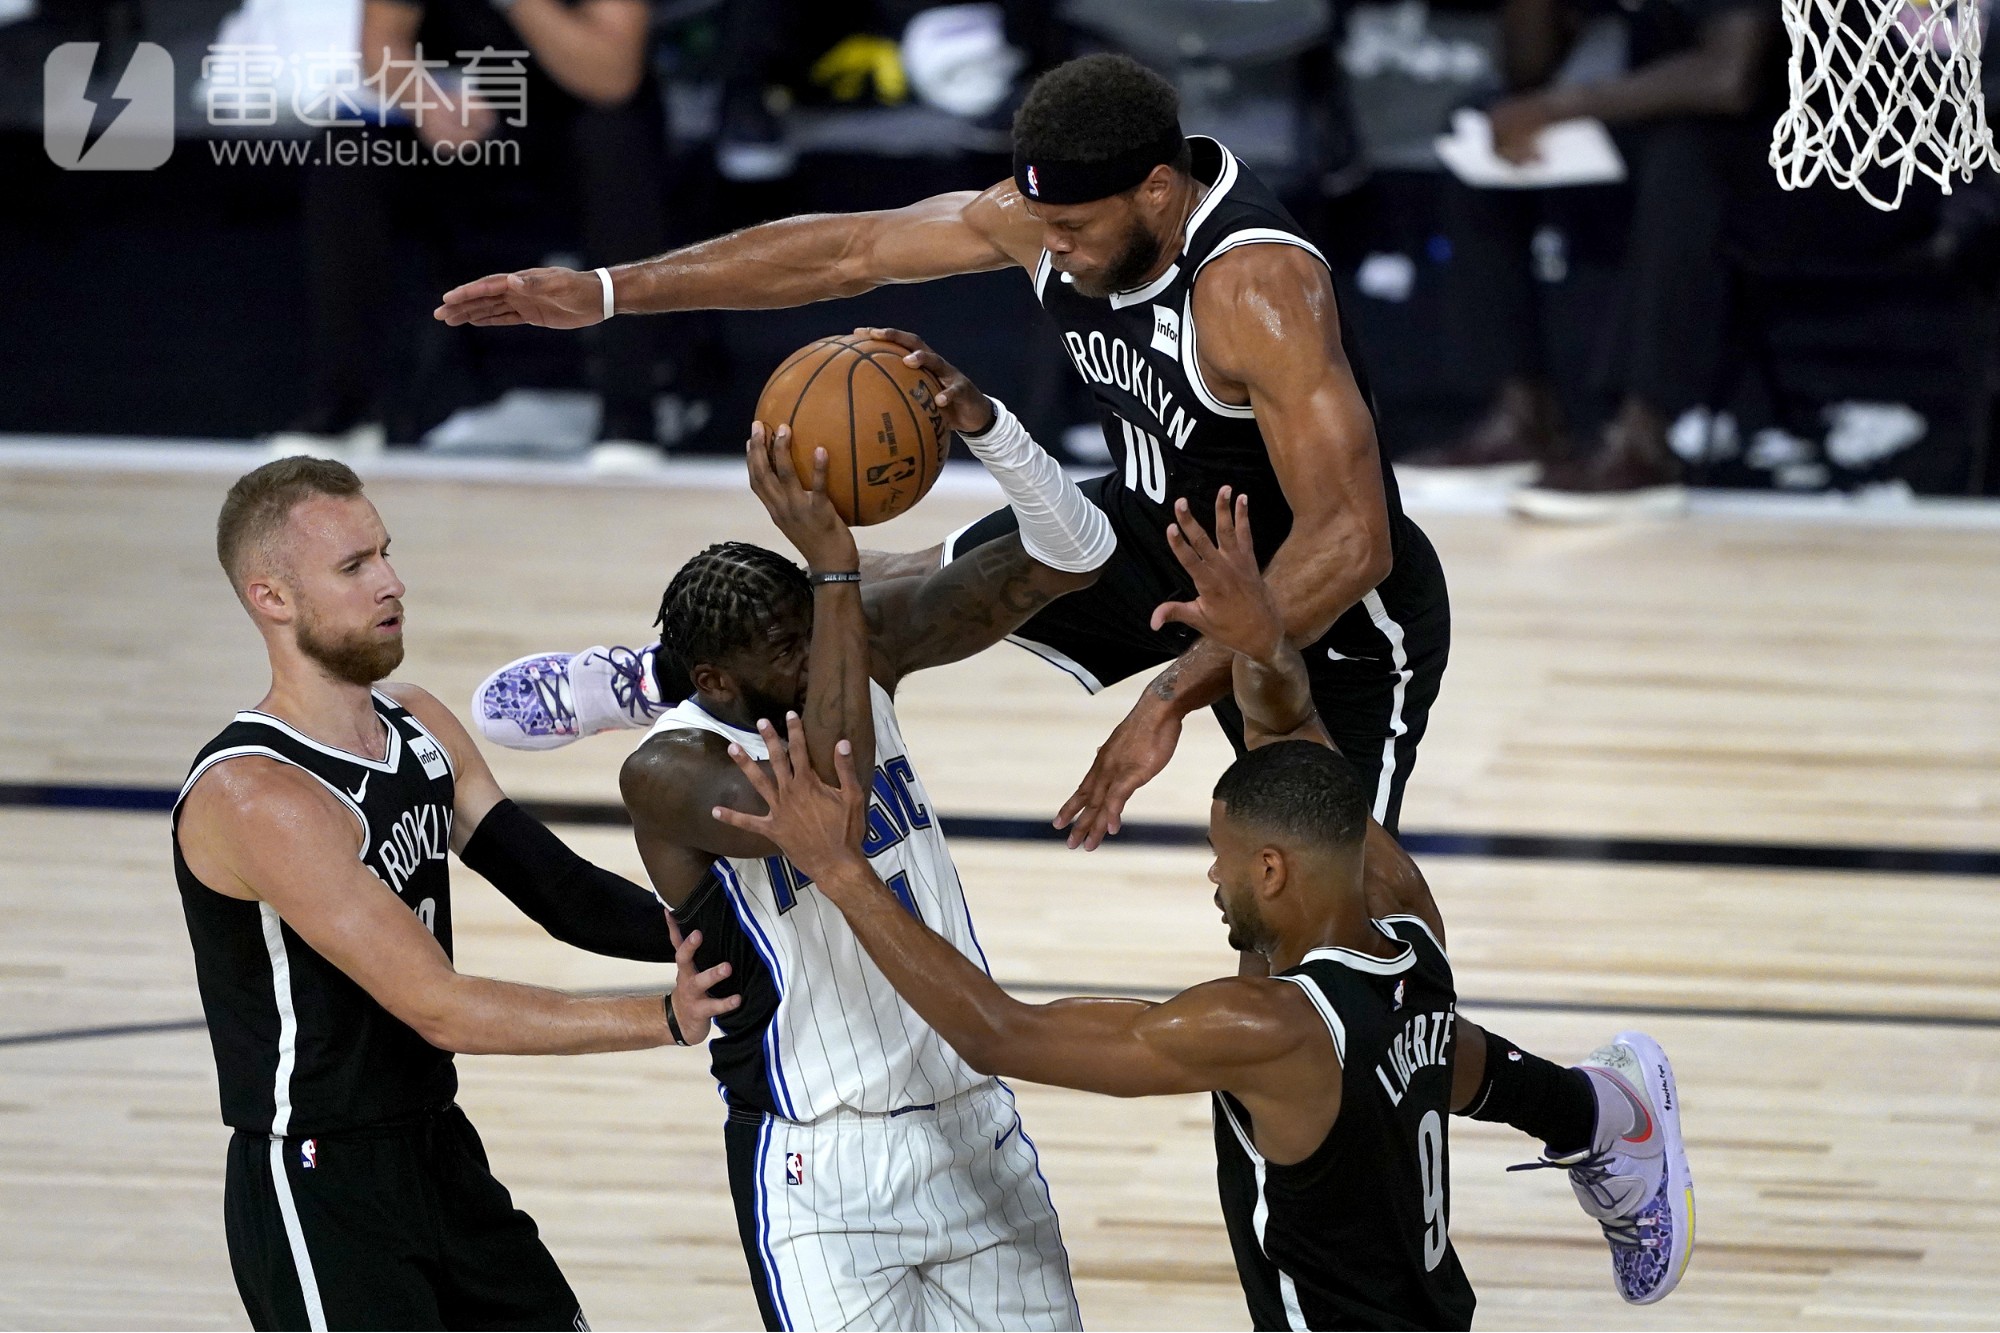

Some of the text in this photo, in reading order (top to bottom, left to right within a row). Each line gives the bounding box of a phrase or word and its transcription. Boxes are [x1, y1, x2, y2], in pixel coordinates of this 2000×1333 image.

[1157, 318, 1178, 343] infor
[1060, 330, 1197, 450] ROOKLYN
[1113, 411, 1166, 505] 10
[417, 748, 439, 765] infor
[367, 804, 453, 893] ROOKLY
[1418, 1109, 1447, 1273] 9
